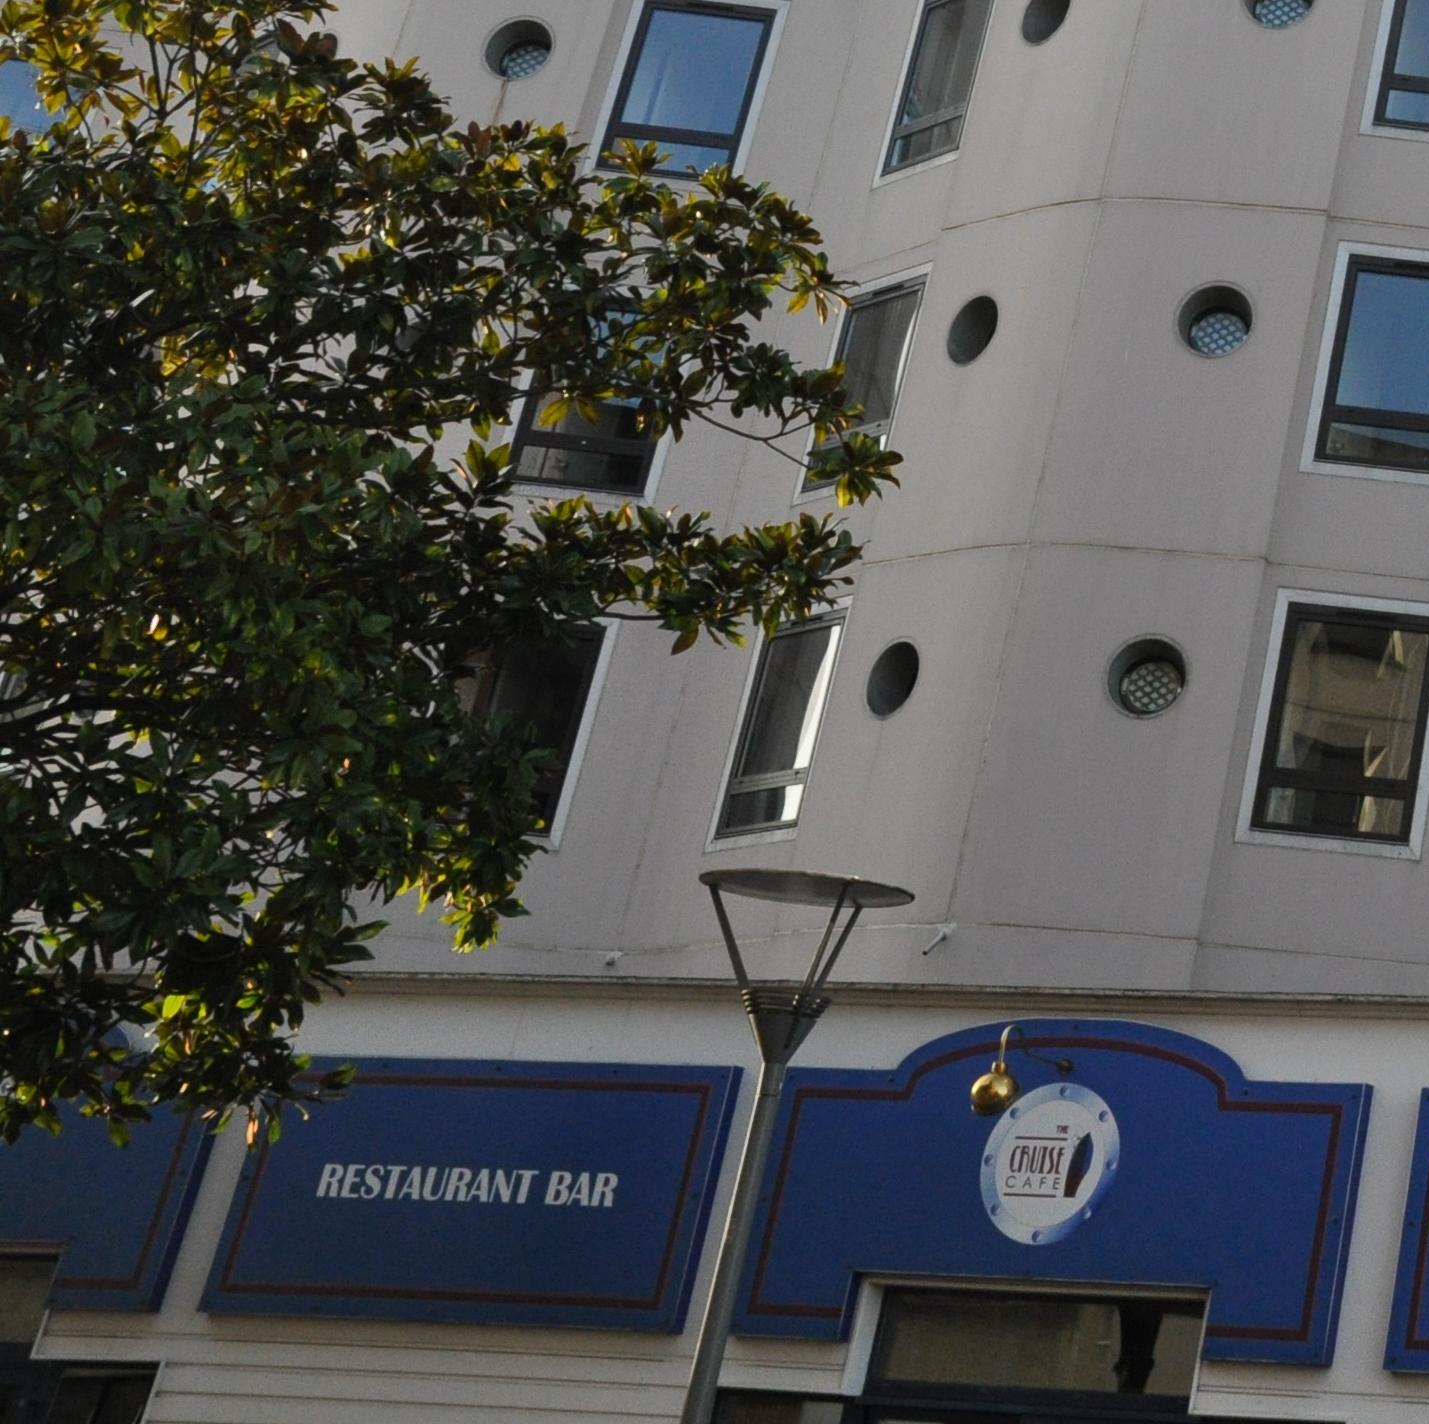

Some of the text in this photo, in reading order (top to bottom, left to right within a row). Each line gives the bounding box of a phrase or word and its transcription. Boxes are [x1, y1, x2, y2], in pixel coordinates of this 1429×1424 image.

[1056, 1125, 1069, 1134] THE
[1009, 1145, 1066, 1175] CRUISE
[316, 1163, 619, 1208] RESTAURANT BAR
[1005, 1176, 1061, 1190] CAFE
